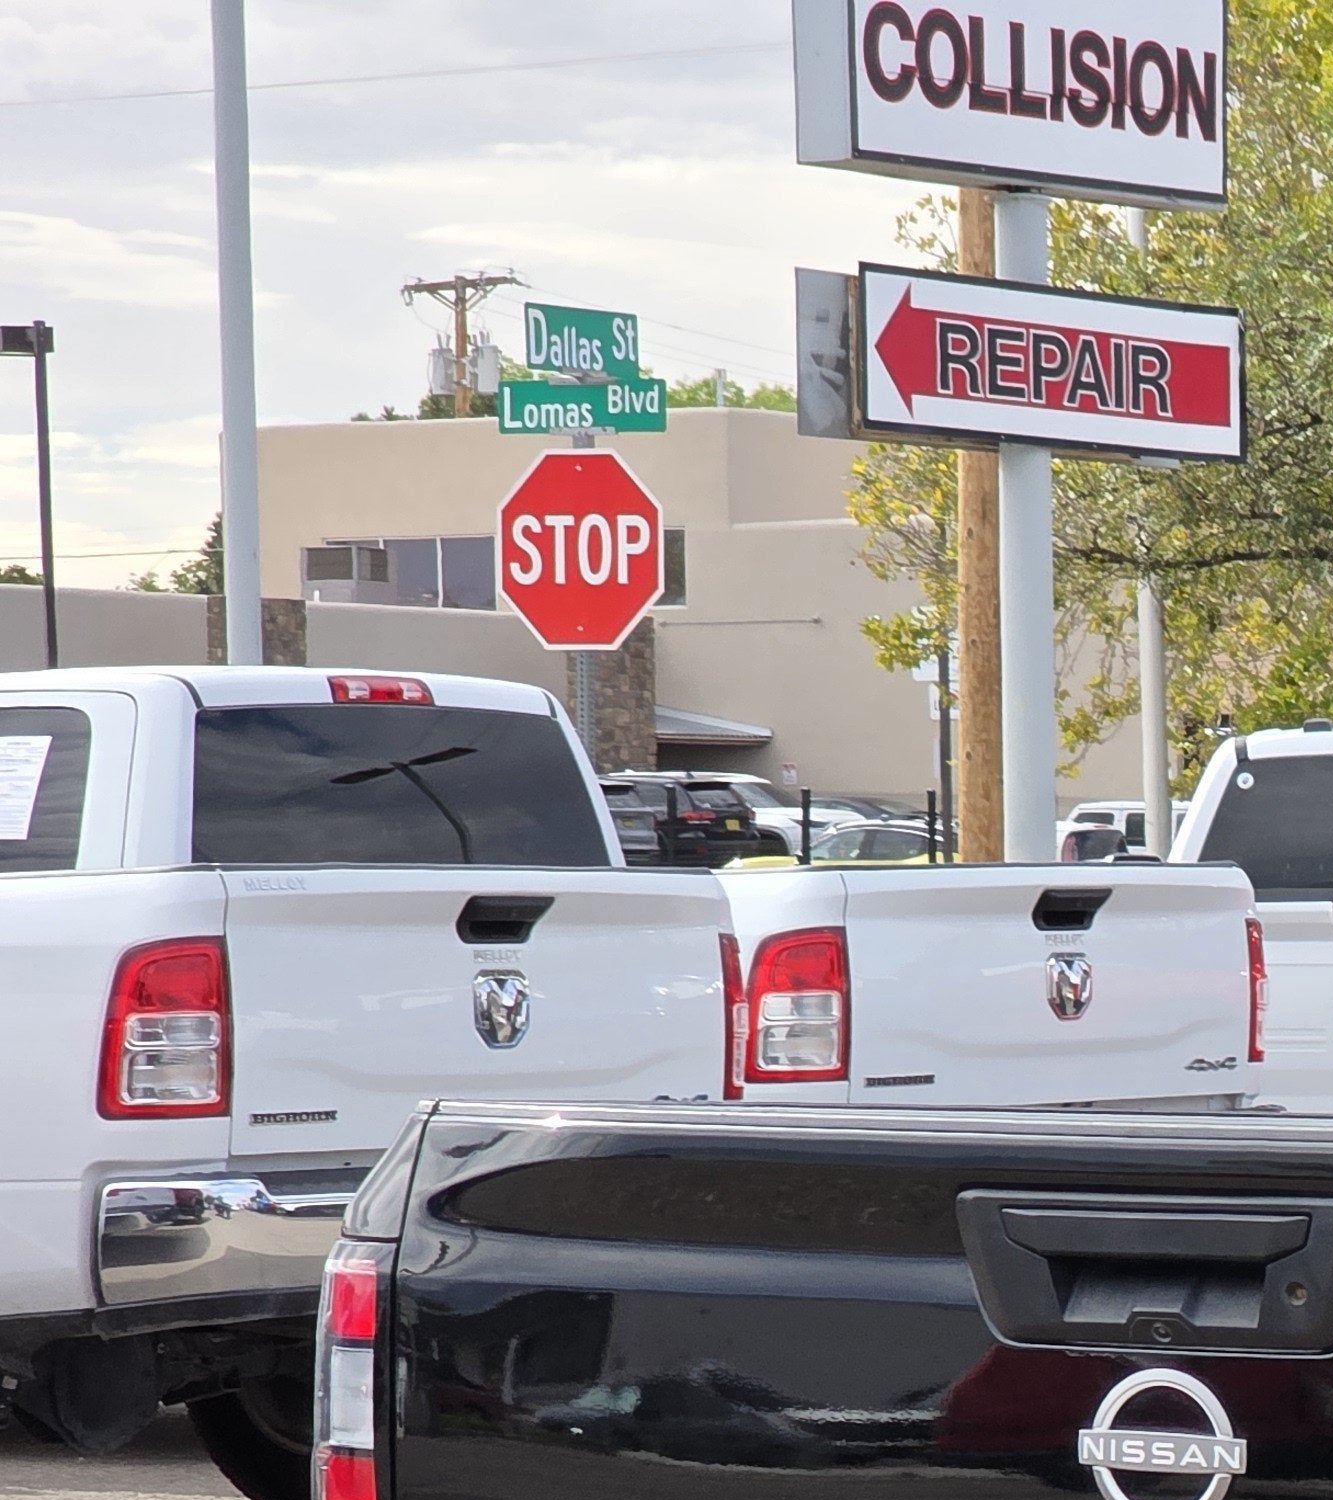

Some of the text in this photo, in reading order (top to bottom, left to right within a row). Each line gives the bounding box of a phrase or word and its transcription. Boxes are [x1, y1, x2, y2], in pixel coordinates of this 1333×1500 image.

[863, 1, 1216, 142] COLLISION
[528, 308, 636, 371] Dallas St
[935, 317, 1174, 419] REPAIR
[503, 384, 659, 429] Lomas Blvd
[509, 514, 651, 585] STOP
[250, 1110, 338, 1126] BIGHORN
[1082, 1436, 1241, 1469] NISSAN
